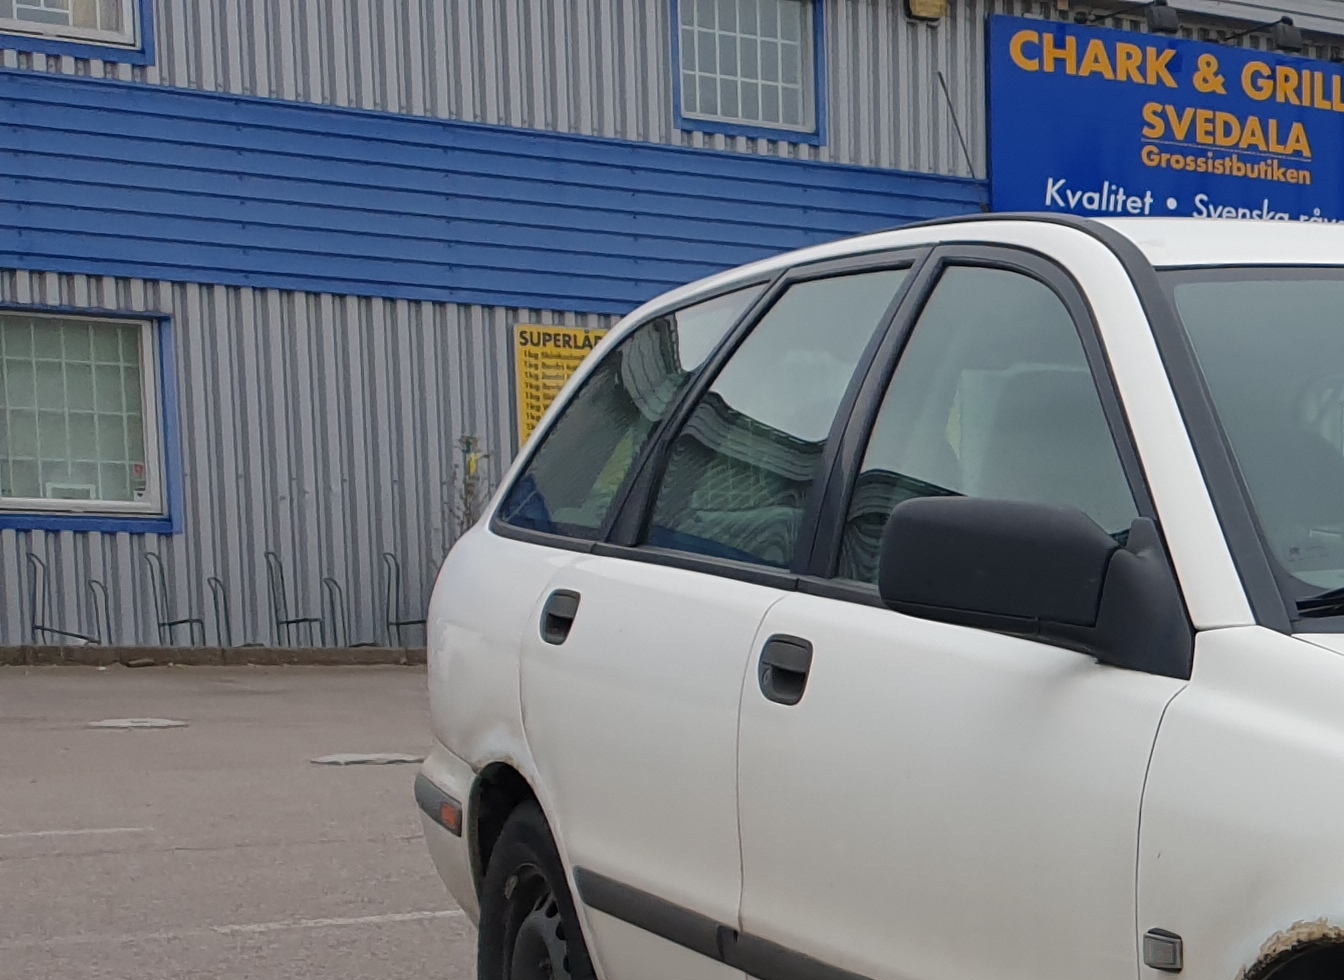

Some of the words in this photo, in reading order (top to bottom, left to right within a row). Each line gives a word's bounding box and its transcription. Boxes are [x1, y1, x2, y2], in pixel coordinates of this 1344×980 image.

[1010, 30, 1177, 88] CHARK
[1193, 54, 1226, 95] &
[1142, 103, 1311, 157] SVEDALA
[1141, 146, 1311, 185] Grossistbutiken
[1046, 178, 1153, 215] Kvalitet
